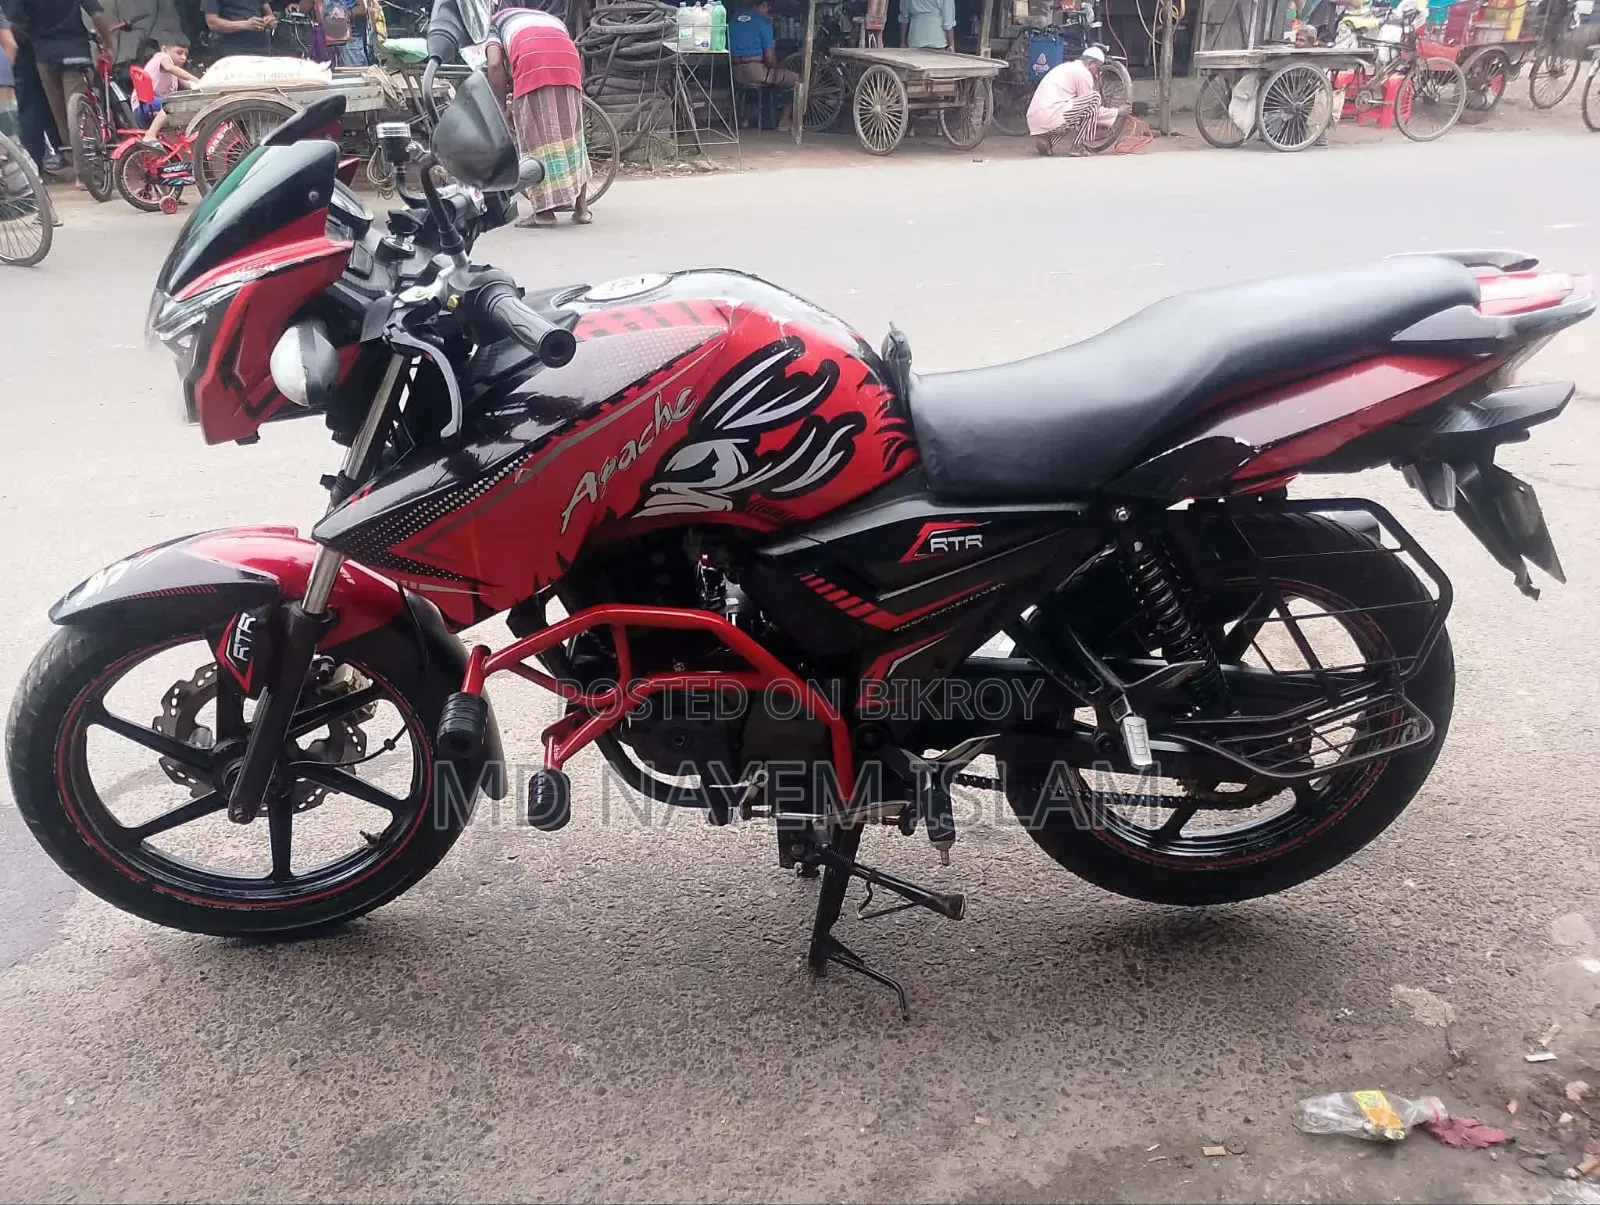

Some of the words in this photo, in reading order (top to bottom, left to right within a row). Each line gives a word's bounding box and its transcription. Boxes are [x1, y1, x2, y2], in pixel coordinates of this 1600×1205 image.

[560, 386, 698, 536] Apache
[930, 534, 983, 552] RTR
[232, 612, 257, 661] RTR
